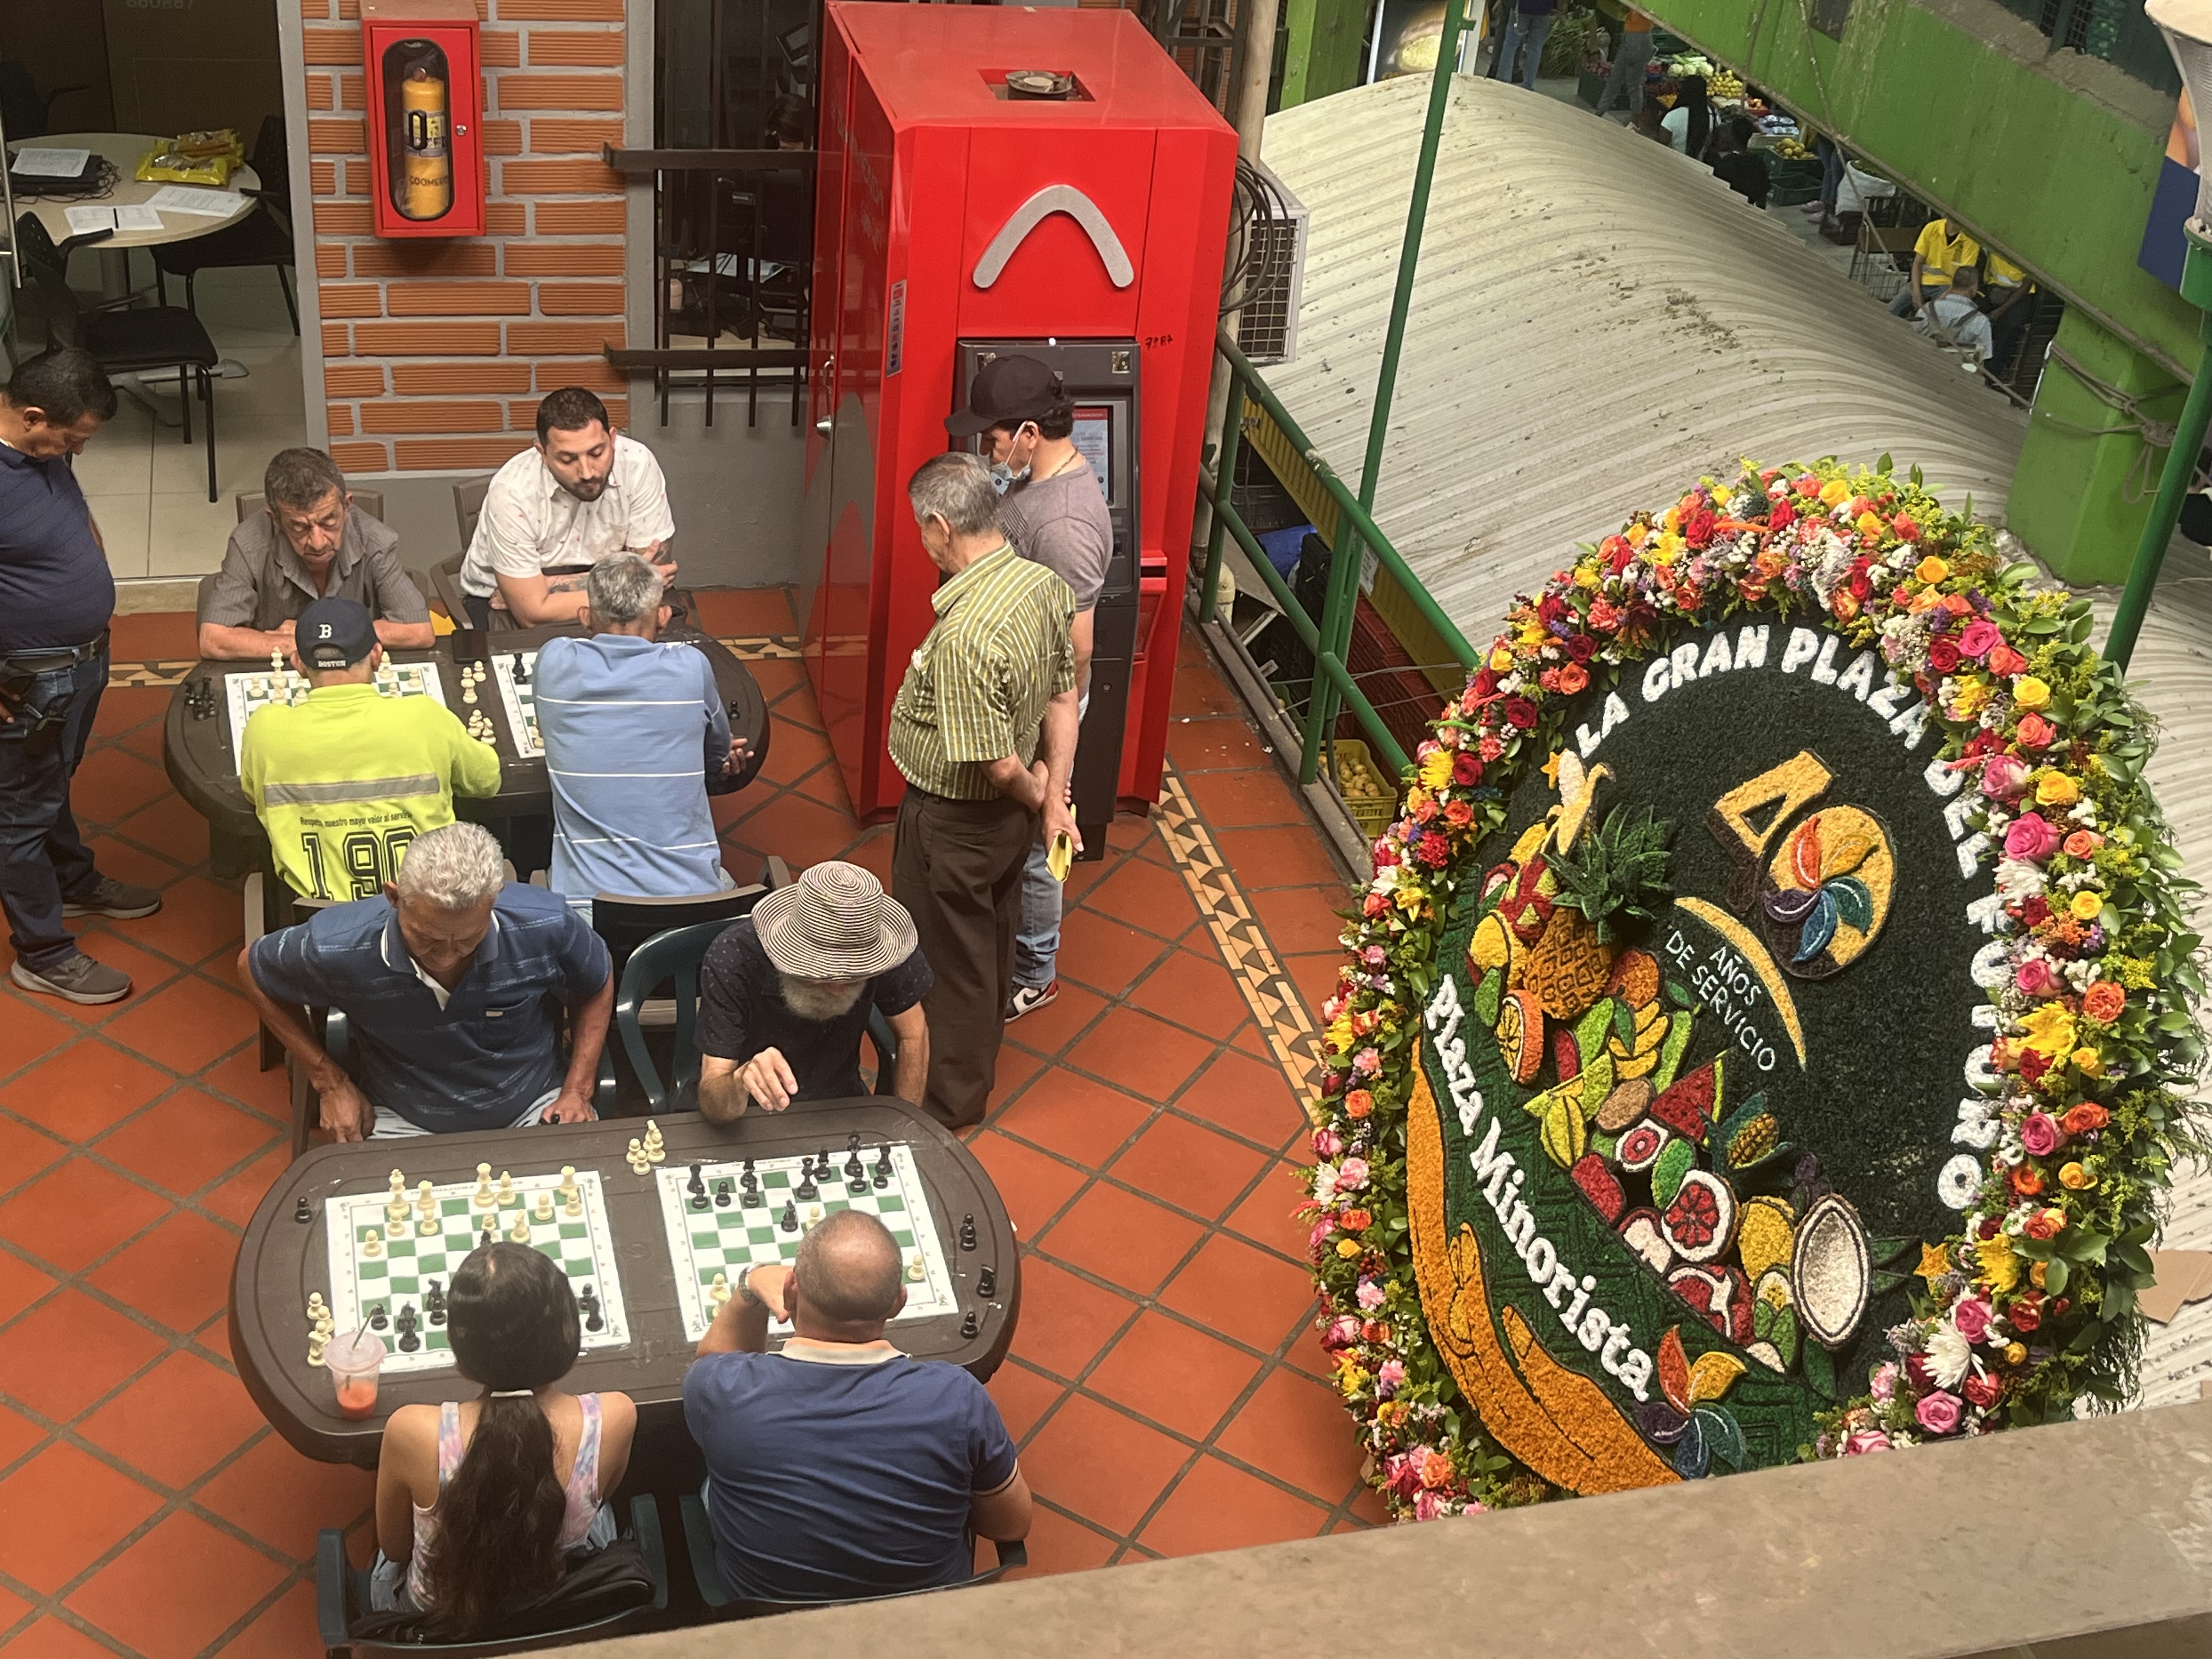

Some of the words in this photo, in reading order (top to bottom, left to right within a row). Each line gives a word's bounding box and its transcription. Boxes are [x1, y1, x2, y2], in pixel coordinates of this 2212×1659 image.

[318, 623, 332, 639] B
[1575, 691, 1630, 758] LA
[1641, 624, 1770, 702] GRAN
[1781, 627, 1933, 751] PLAZA
[1705, 748, 1897, 979] 40
[1665, 930, 1695, 971] DE
[1690, 965, 1776, 1071] SERVICIO
[1709, 945, 1762, 1006] AÑOS
[1424, 974, 1483, 1136] Plaza
